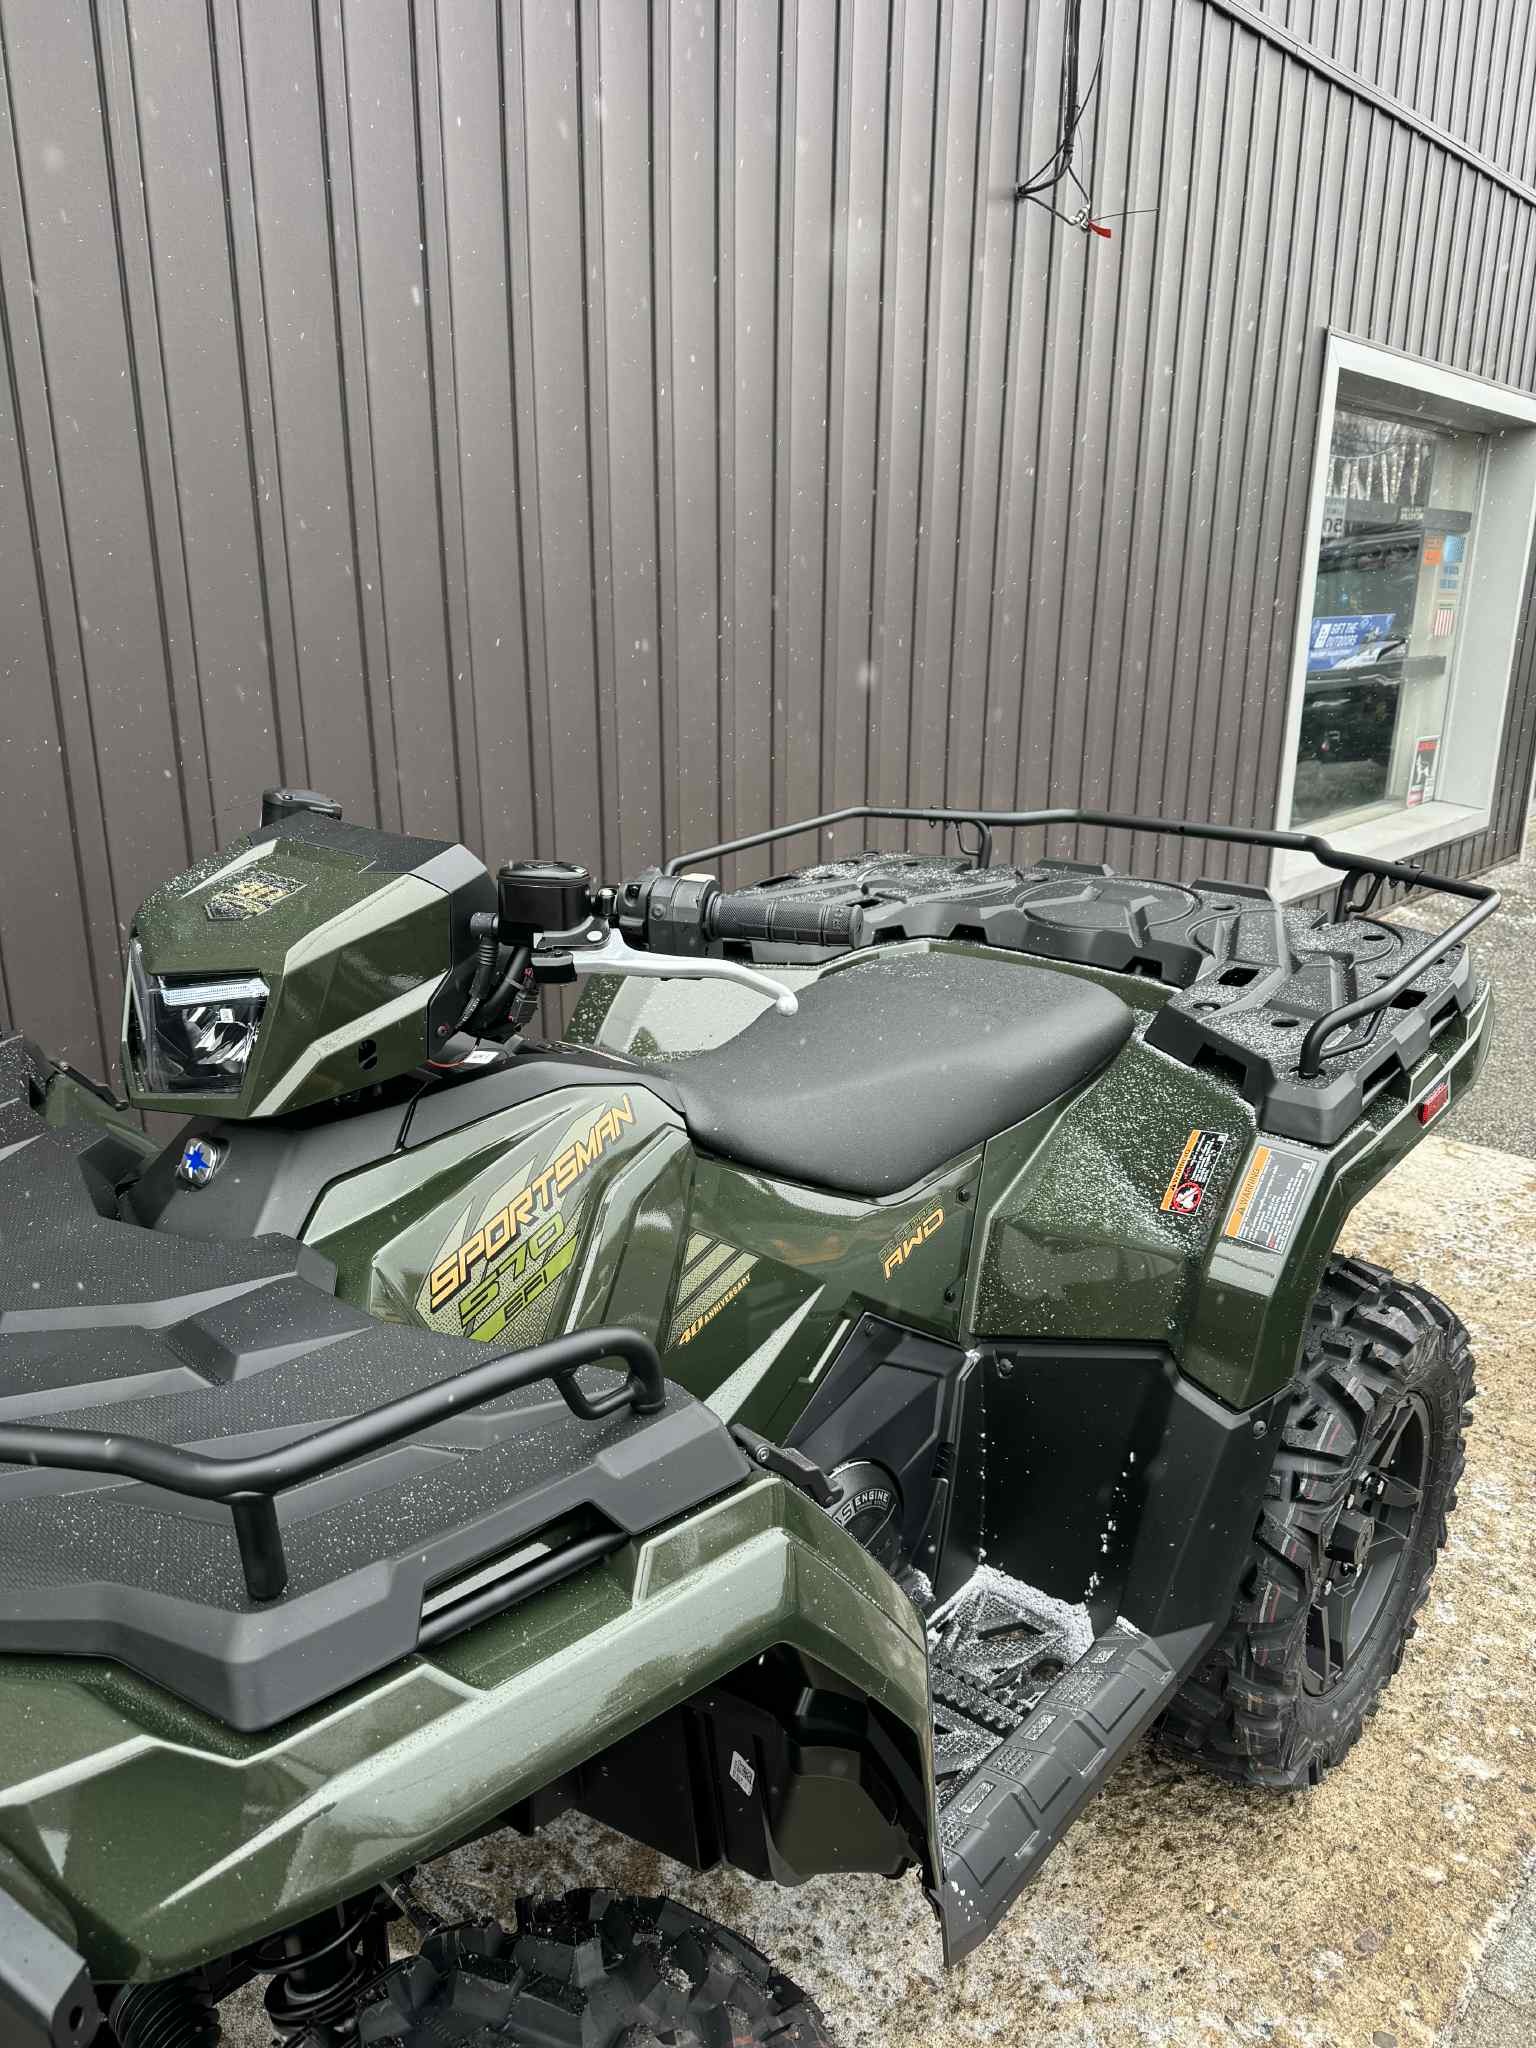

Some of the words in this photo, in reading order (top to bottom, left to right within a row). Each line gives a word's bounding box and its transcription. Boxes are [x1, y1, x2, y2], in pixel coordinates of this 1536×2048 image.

[430, 1094, 637, 1313] SPORTSMAN
[1239, 1168, 1261, 1210] WARNING
[458, 1211, 565, 1329] 570
[884, 1208, 944, 1280] AWD
[504, 1269, 548, 1321] EFI
[704, 1273, 751, 1325] ANNIVERSARY
[855, 1491, 889, 1506] ENGINE
